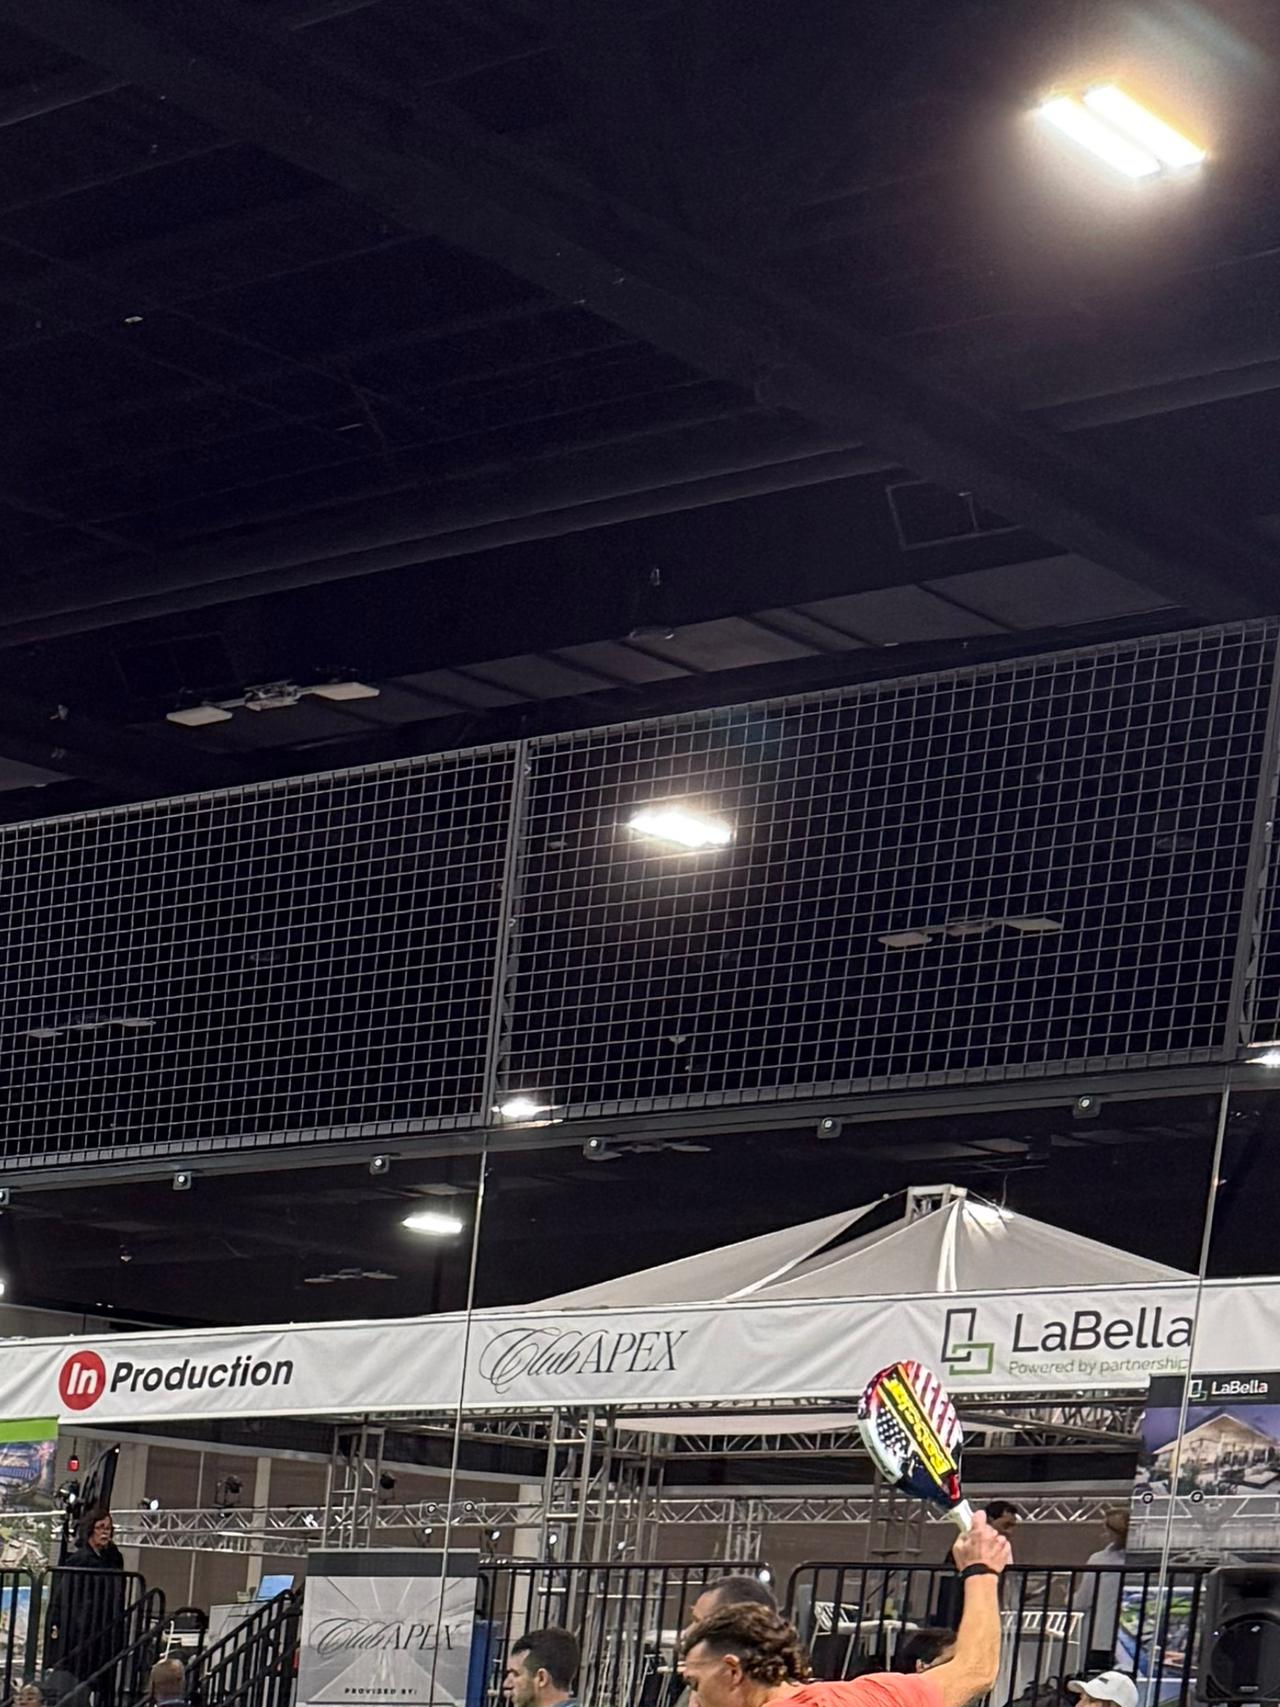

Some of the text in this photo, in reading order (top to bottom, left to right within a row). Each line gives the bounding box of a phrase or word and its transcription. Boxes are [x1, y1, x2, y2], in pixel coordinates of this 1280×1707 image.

[1011, 1306, 1194, 1353] LaBella
[66, 1354, 294, 1396] In Production
[478, 1326, 690, 1395] Club APEX
[1008, 1360, 1075, 1376] Powered
[1078, 1358, 1097, 1374] by
[1211, 1380, 1269, 1397] LaBella
[308, 1617, 405, 1660] Club
[344, 1687, 397, 1695] PROVIDED
